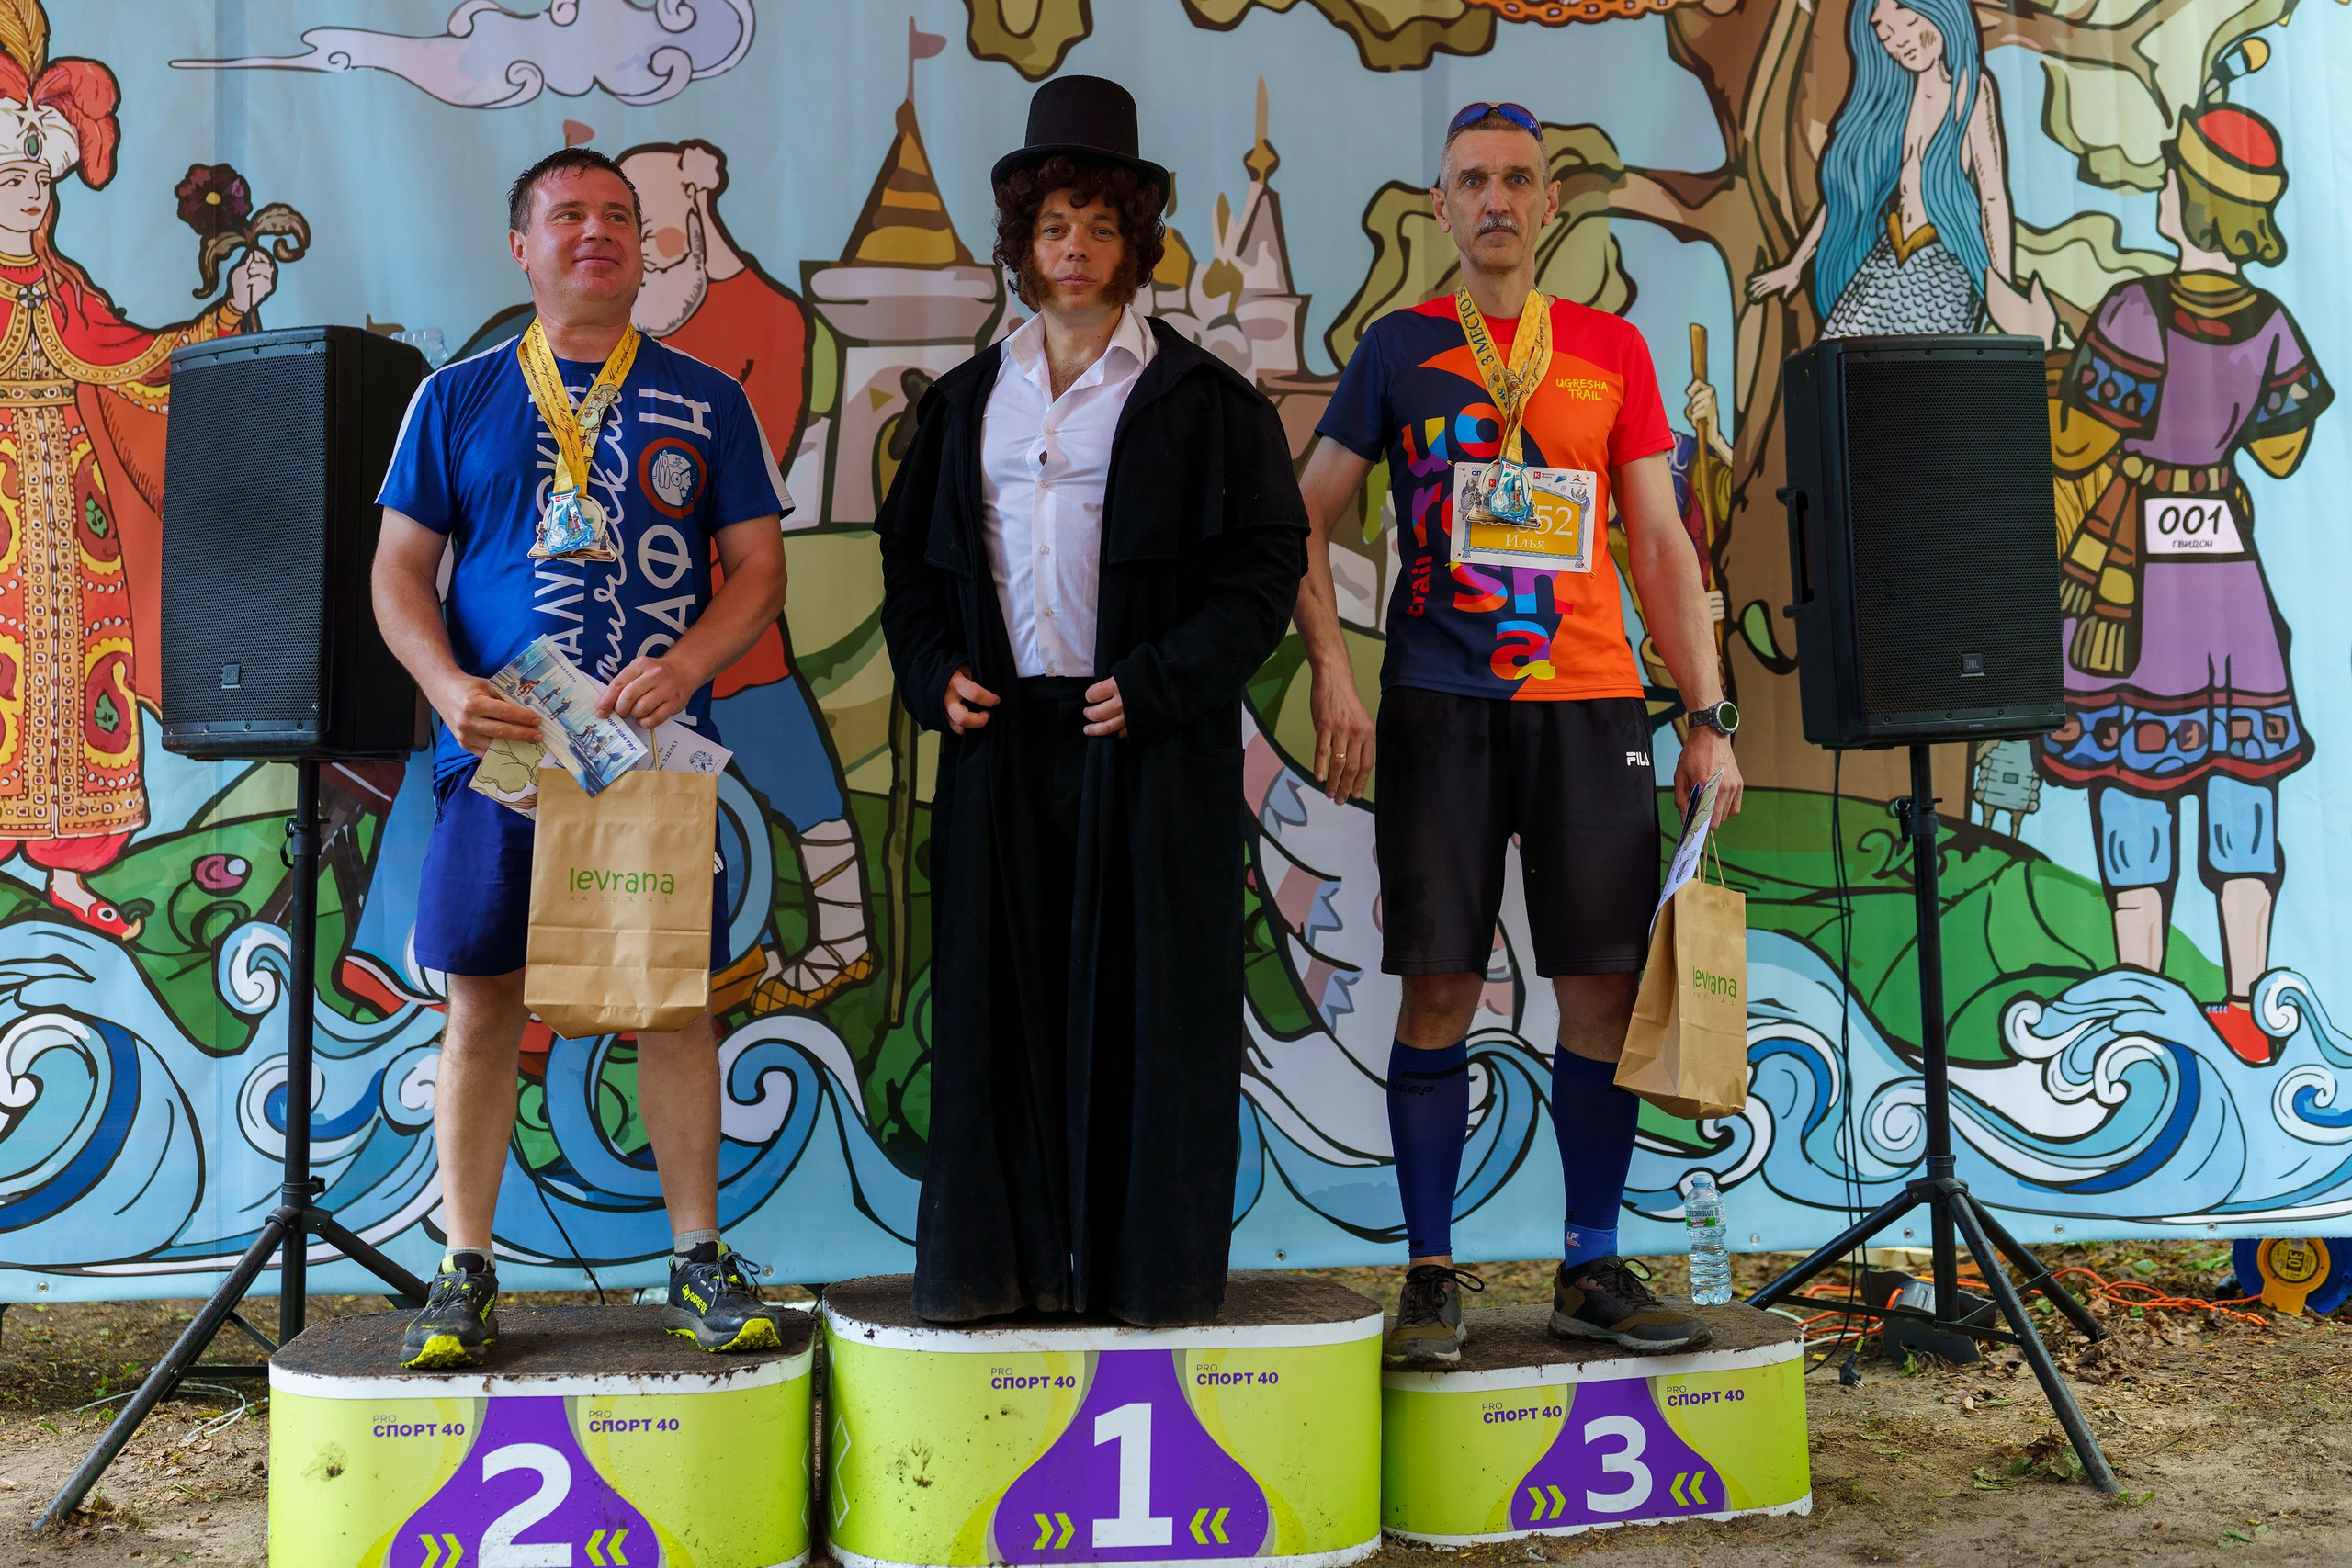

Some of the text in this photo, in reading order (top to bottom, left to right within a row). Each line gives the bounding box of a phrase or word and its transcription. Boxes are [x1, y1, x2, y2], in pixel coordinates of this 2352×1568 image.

[1459, 298, 1490, 355] МЕСТО
[1555, 378, 1609, 393] UGRESHA
[1567, 389, 1603, 401] TRAIL
[1516, 505, 1573, 536] 52
[2158, 505, 2222, 535] 001
[1505, 533, 1545, 550] Илья
[2172, 539, 2213, 548] ГВИДОН
[1405, 555, 1432, 619] trail
[541, 644, 578, 683] ПОДАРОЧНАЯ КАРТА
[1966, 659, 1980, 669] JBL
[1625, 751, 1650, 767] FILA
[570, 867, 675, 895] levrana
[1692, 965, 1737, 998] levrana
[2288, 1250, 2304, 1268] 30
[990, 1367, 1013, 1376] PRO
[1196, 1363, 1218, 1372] PRO
[991, 1375, 1076, 1389] СПОРТ 40
[1197, 1371, 1279, 1385] СПОРТ 40
[1667, 1385, 1687, 1394] PRO
[1668, 1389, 1745, 1407] СПОРТ 40
[588, 1410, 613, 1419] PRO
[1482, 1402, 1503, 1411] PRO
[1483, 1405, 1563, 1424] СПОРТ 40
[372, 1414, 397, 1423] PRO
[589, 1418, 680, 1433] СПОРТ 40
[373, 1423, 465, 1438] СПОРТ 40
[1584, 1415, 1654, 1513] 3
[1092, 1403, 1173, 1548] 1
[478, 1442, 572, 1568] 2
